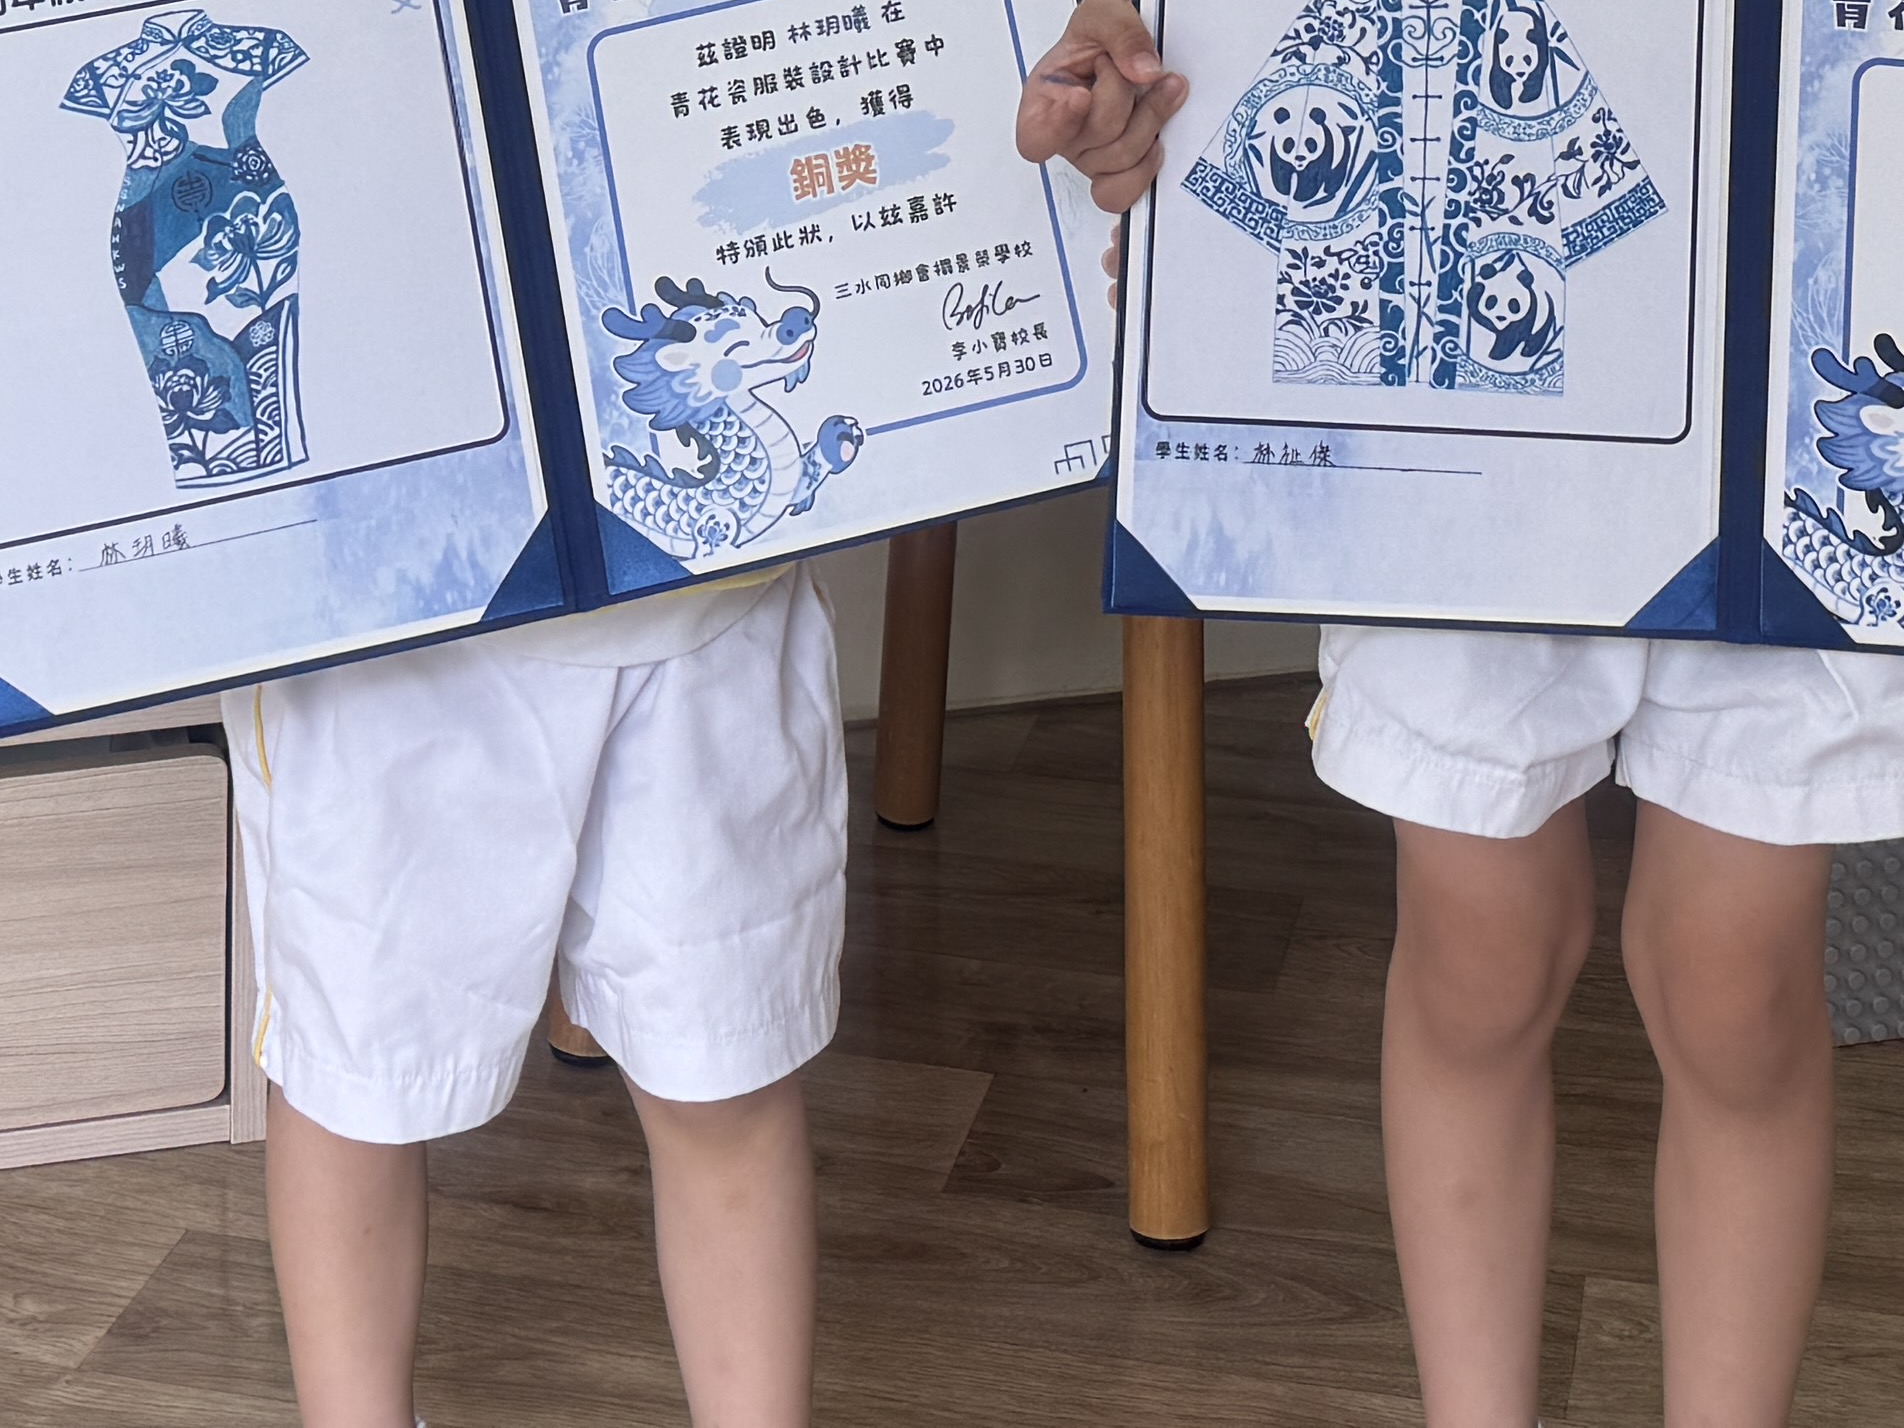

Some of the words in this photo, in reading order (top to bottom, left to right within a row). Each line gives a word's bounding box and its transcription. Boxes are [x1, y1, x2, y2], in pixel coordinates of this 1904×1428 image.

[880, 0, 907, 25] 在
[668, 33, 946, 119] 青花瓷服裝設計比賽中
[788, 143, 879, 202] 銅獎
[920, 351, 1054, 397] 2026年5月30日
